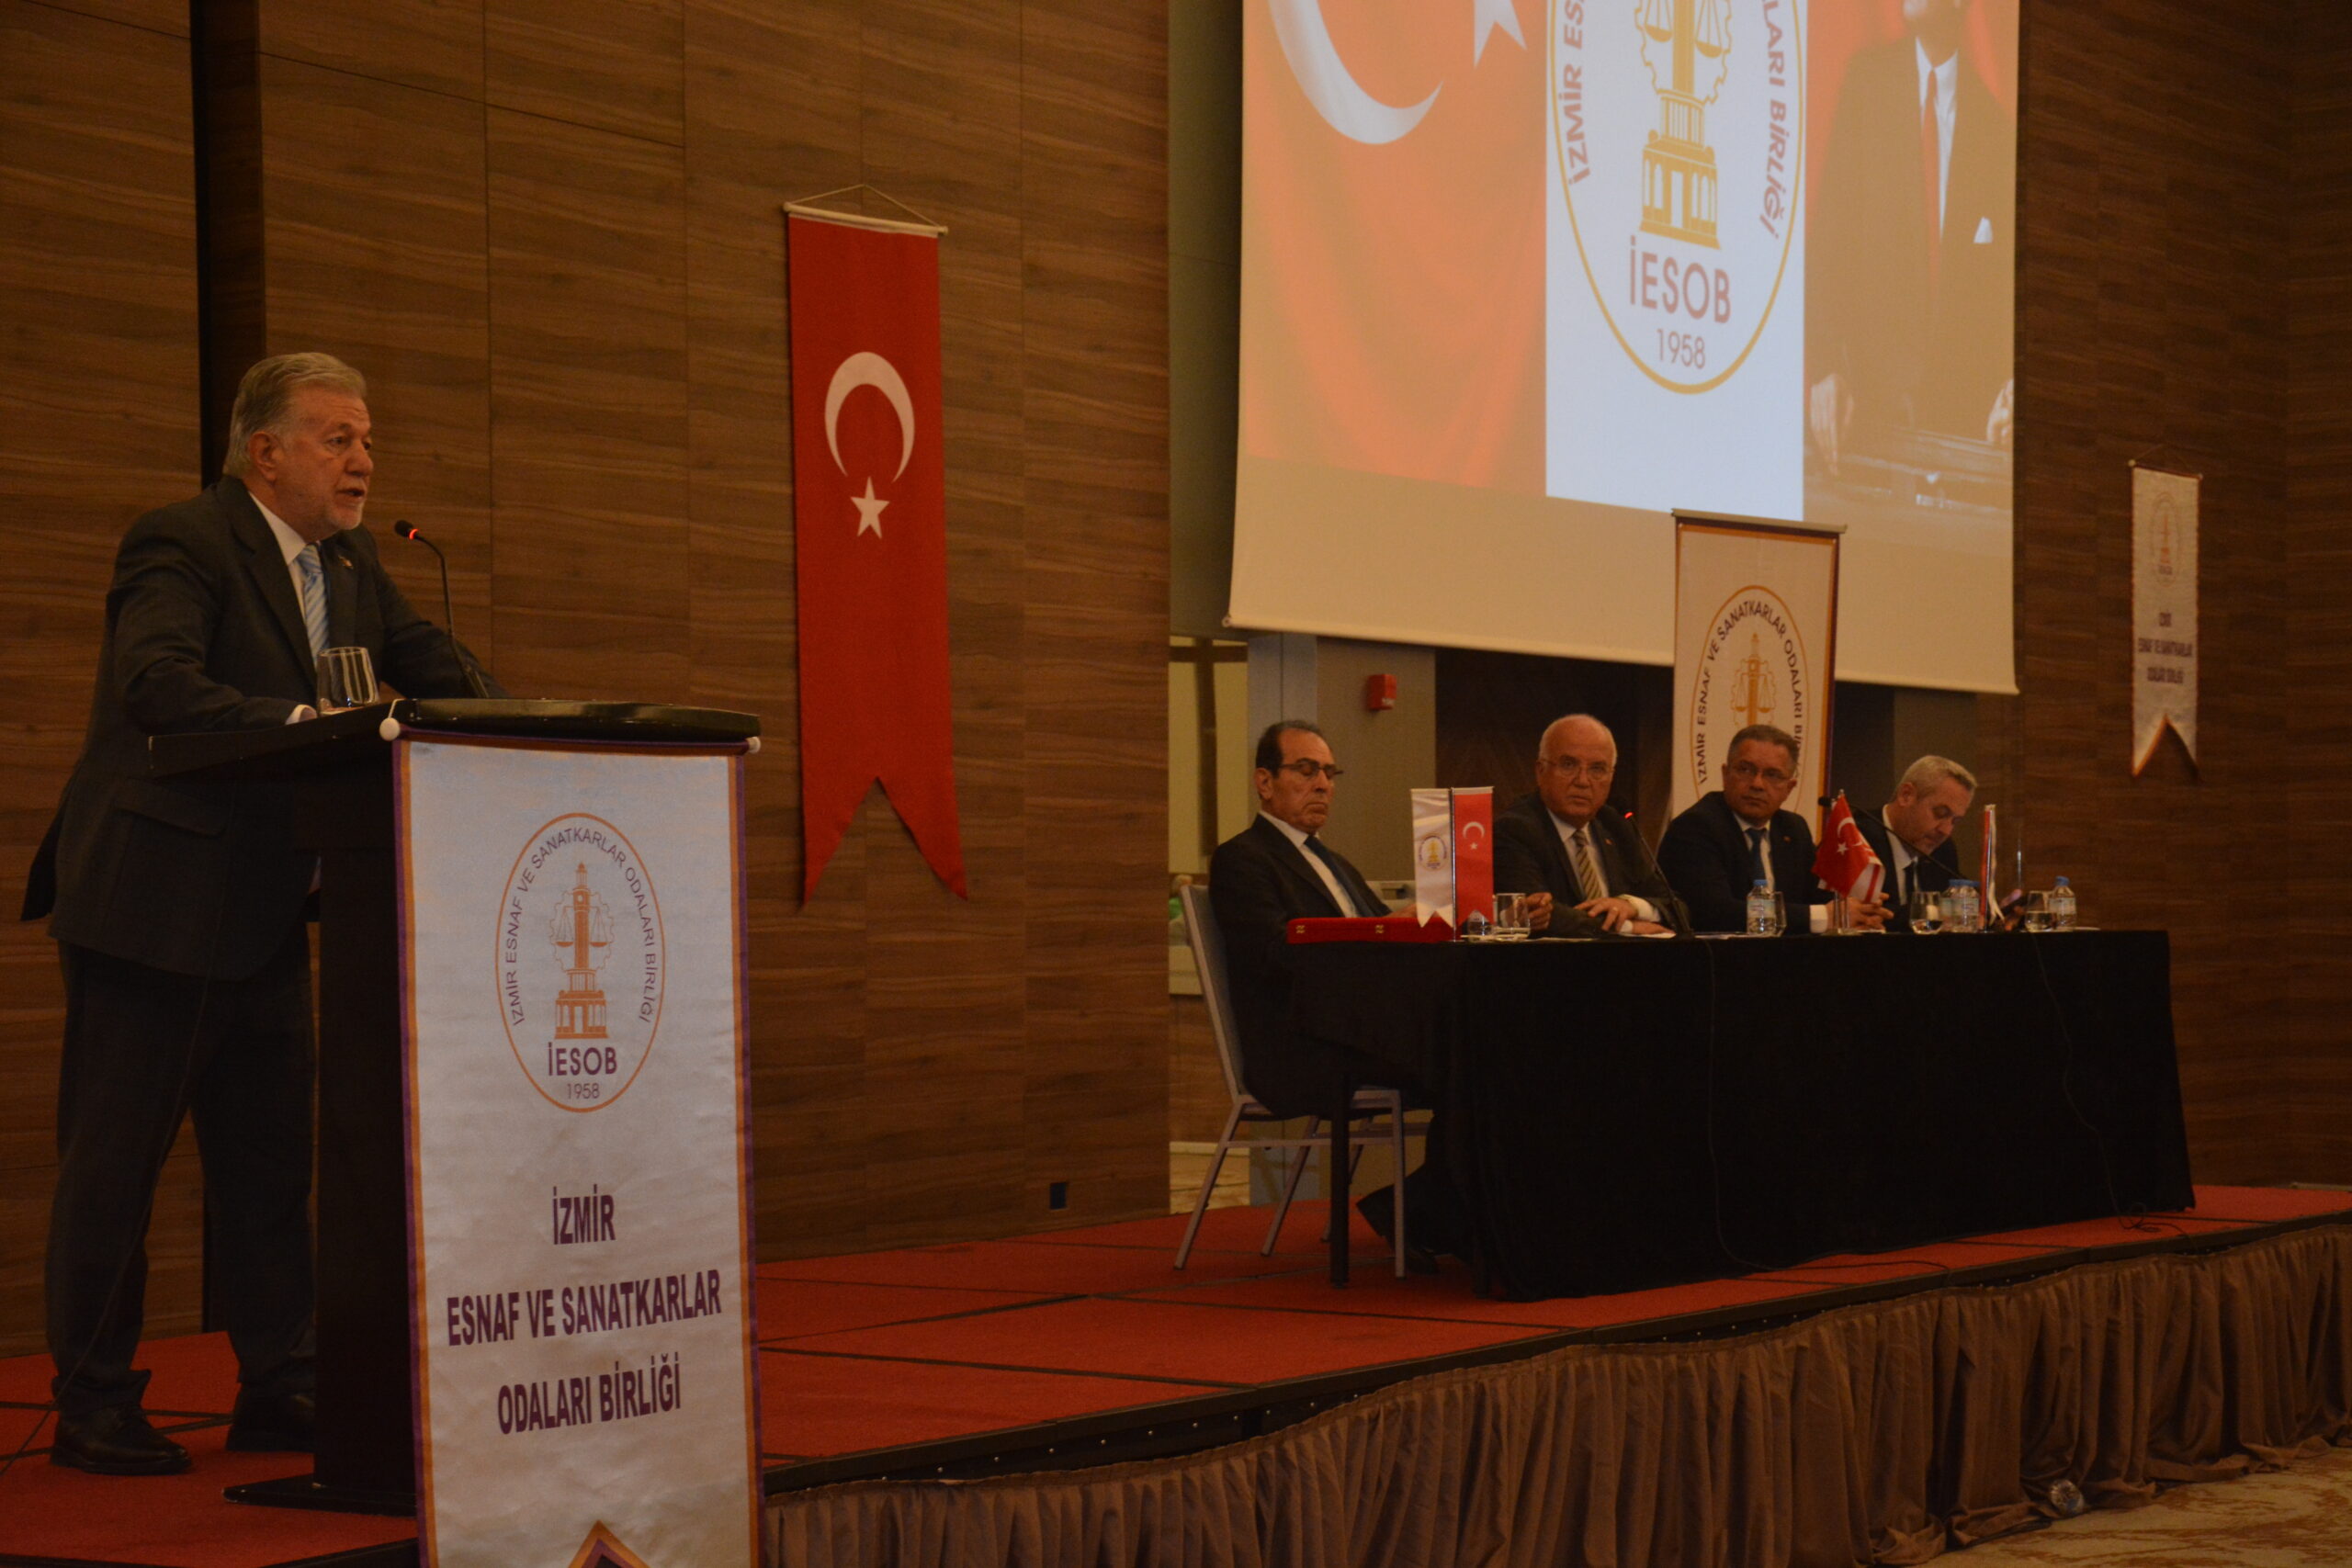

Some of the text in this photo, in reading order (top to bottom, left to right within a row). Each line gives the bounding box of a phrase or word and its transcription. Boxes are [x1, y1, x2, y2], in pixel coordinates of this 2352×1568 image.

[1558, 0, 1590, 185] İZMİR ES
[1759, 0, 1791, 239] LARI BİRLİĞİ
[1630, 235, 1731, 323] İESOB
[1657, 329, 1706, 369] 1958
[1697, 668, 1711, 726] ESNAF
[1707, 639, 1720, 661] VE
[1717, 600, 1786, 641] SANATKARLAR
[1784, 639, 1803, 718] ODALARI
[505, 897, 523, 964] ESNAF
[517, 868, 536, 893] VE
[531, 827, 626, 868] SANATKARLAR
[625, 867, 655, 947] ODALARI
[548, 1042, 617, 1077] İESOB
[567, 1083, 600, 1100] 1958
[553, 1183, 616, 1246] İZMİR
[447, 1269, 722, 1347] ESNAF VE SANATKARLAR
[498, 1351, 681, 1435] ODALARI BİRLİĞİ
